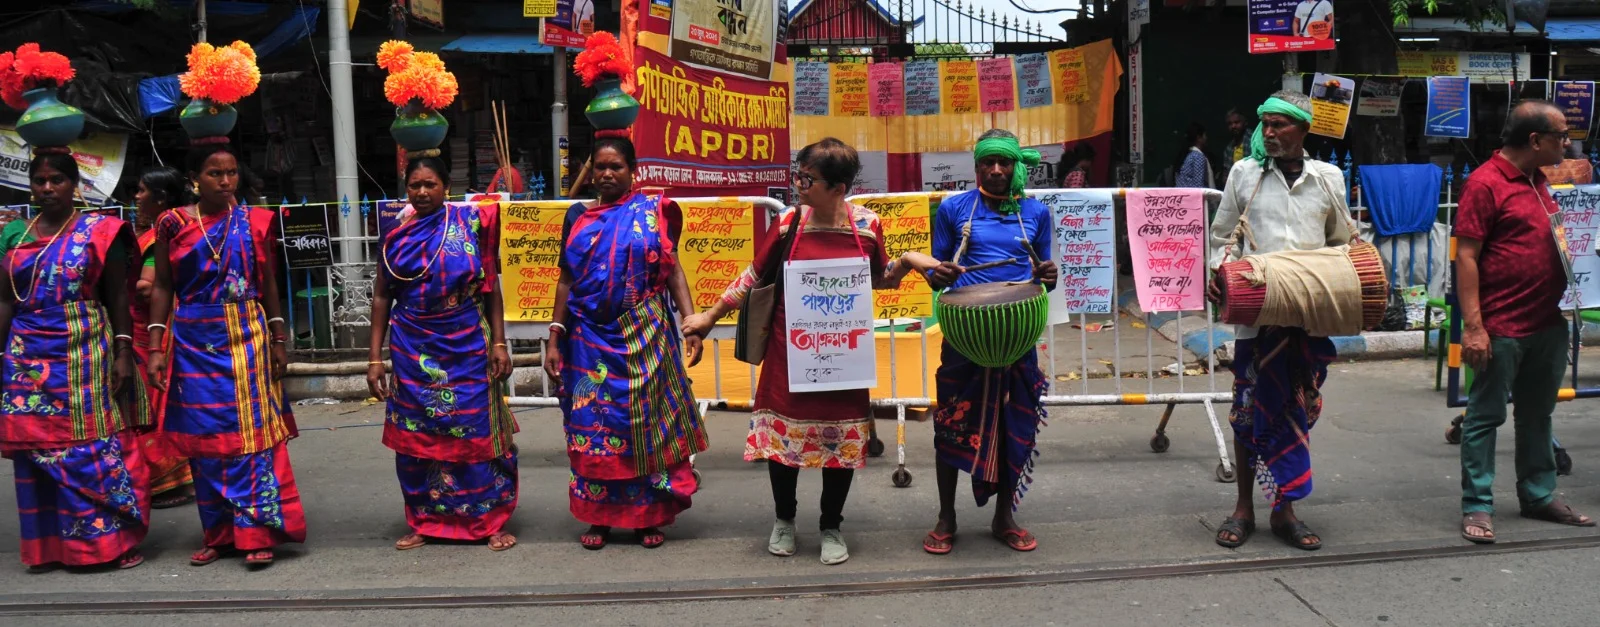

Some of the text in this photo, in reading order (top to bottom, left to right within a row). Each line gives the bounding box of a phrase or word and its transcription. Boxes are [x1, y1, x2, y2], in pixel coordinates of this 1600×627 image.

[1086, 304, 1108, 312] APDR
[1151, 297, 1182, 309] APDR
[520, 310, 553, 319] APD
[879, 306, 918, 319] APDR
